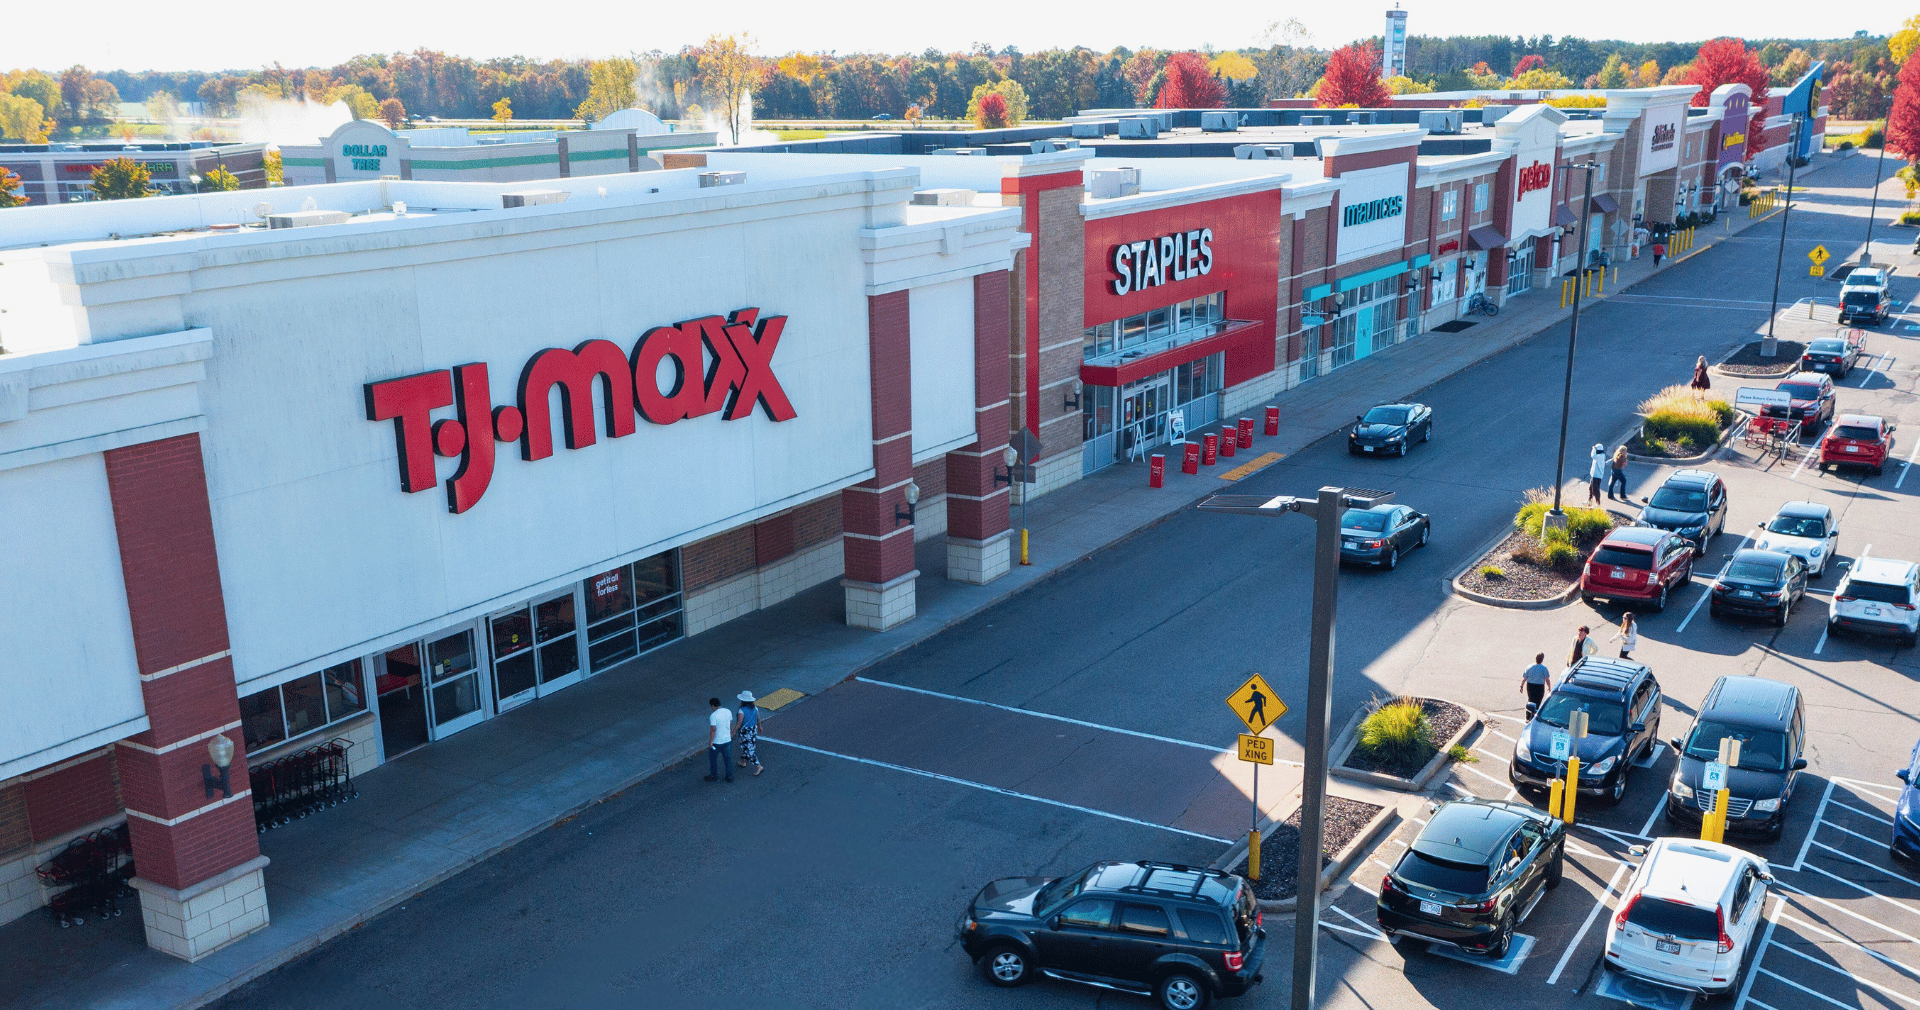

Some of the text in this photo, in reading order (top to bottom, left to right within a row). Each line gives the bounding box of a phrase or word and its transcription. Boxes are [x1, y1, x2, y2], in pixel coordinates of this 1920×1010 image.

[343, 144, 387, 157] DOLLAR
[352, 158, 380, 171] TREE
[1517, 160, 1551, 202] petco
[1344, 195, 1403, 227] maurices
[1111, 227, 1213, 296] STAPLES
[596, 578, 606, 590] get
[598, 585, 618, 596] for less
[1247, 739, 1265, 749] PED
[1245, 749, 1267, 760] XING
